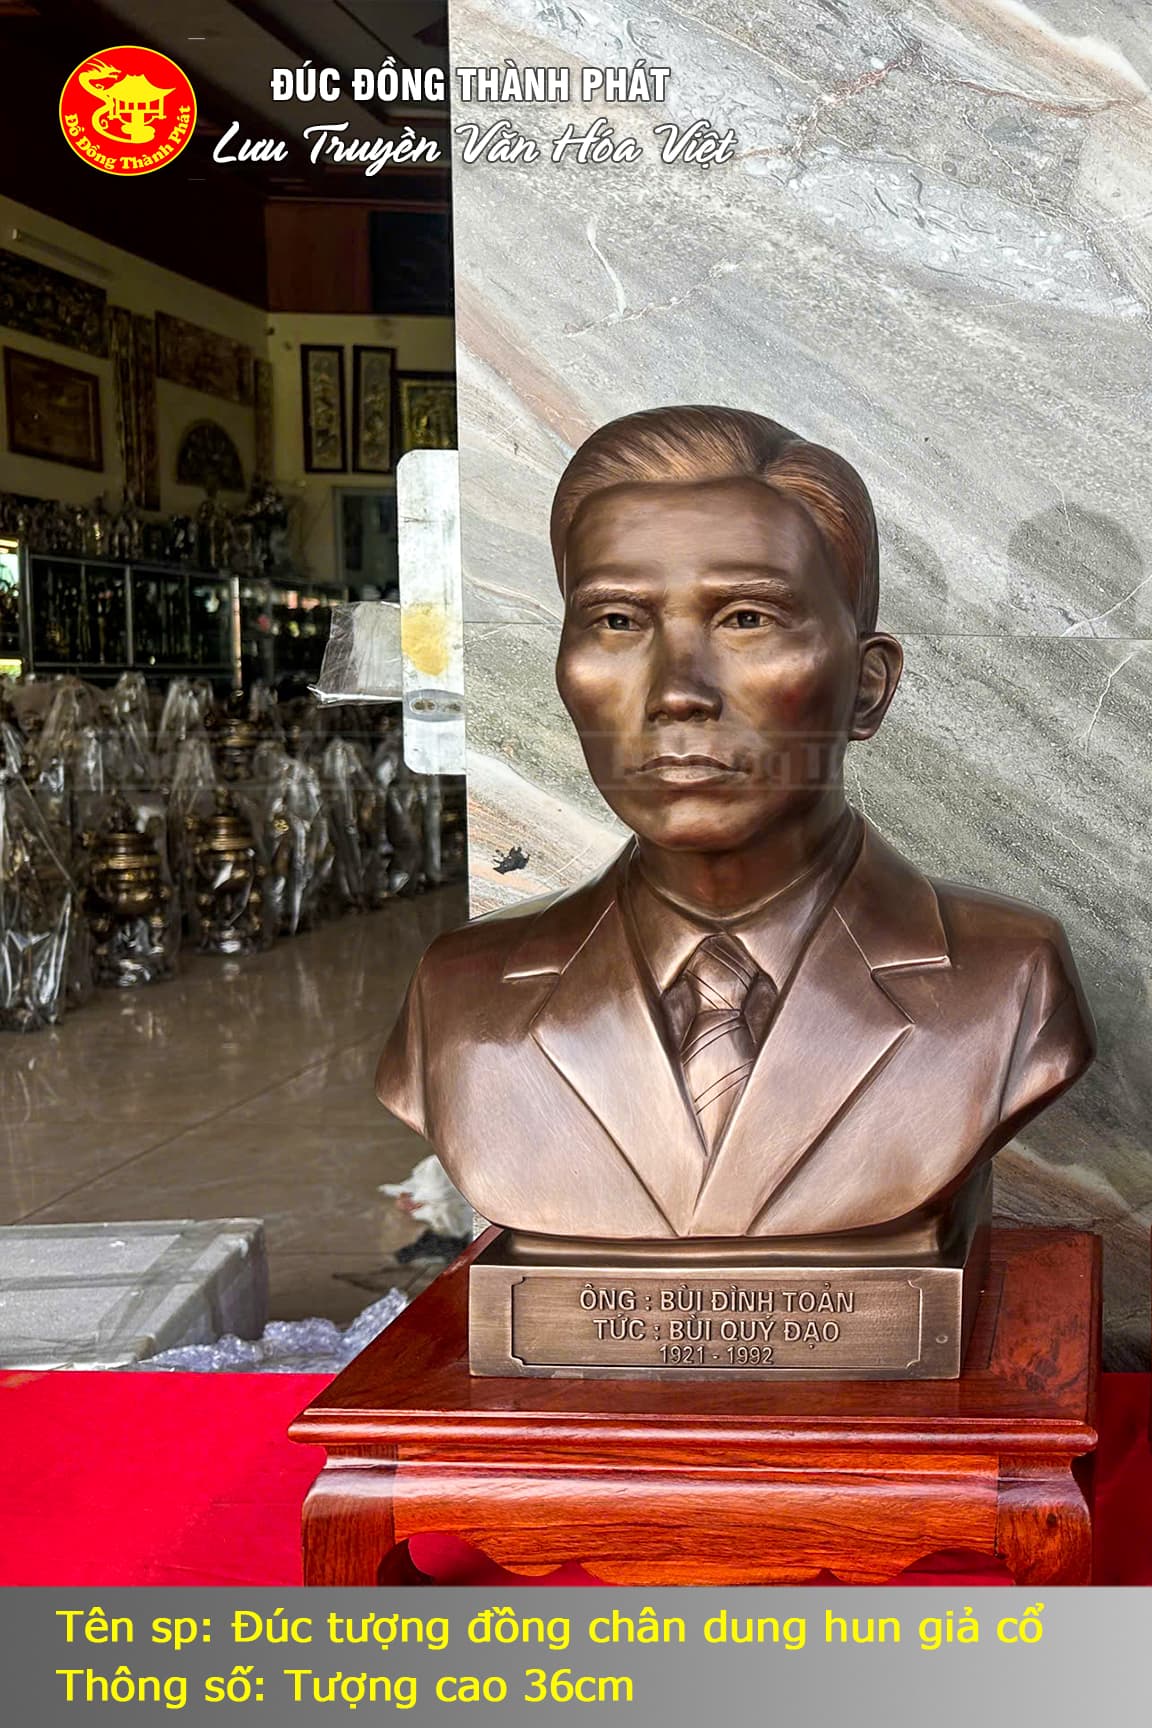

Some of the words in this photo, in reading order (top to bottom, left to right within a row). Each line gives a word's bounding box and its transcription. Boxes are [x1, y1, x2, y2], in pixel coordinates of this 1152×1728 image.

[579, 1283, 637, 1312] ÔNG
[660, 1285, 701, 1312] BÙI
[711, 1285, 775, 1312] ĐÌNH
[782, 1282, 855, 1313] TOẢN
[592, 1312, 647, 1341] TỨC
[669, 1314, 712, 1342] BÙI
[720, 1313, 776, 1342] QUÝ
[783, 1320, 840, 1349] ĐẠO
[658, 1344, 706, 1365] 1921
[727, 1345, 774, 1366] 1992
